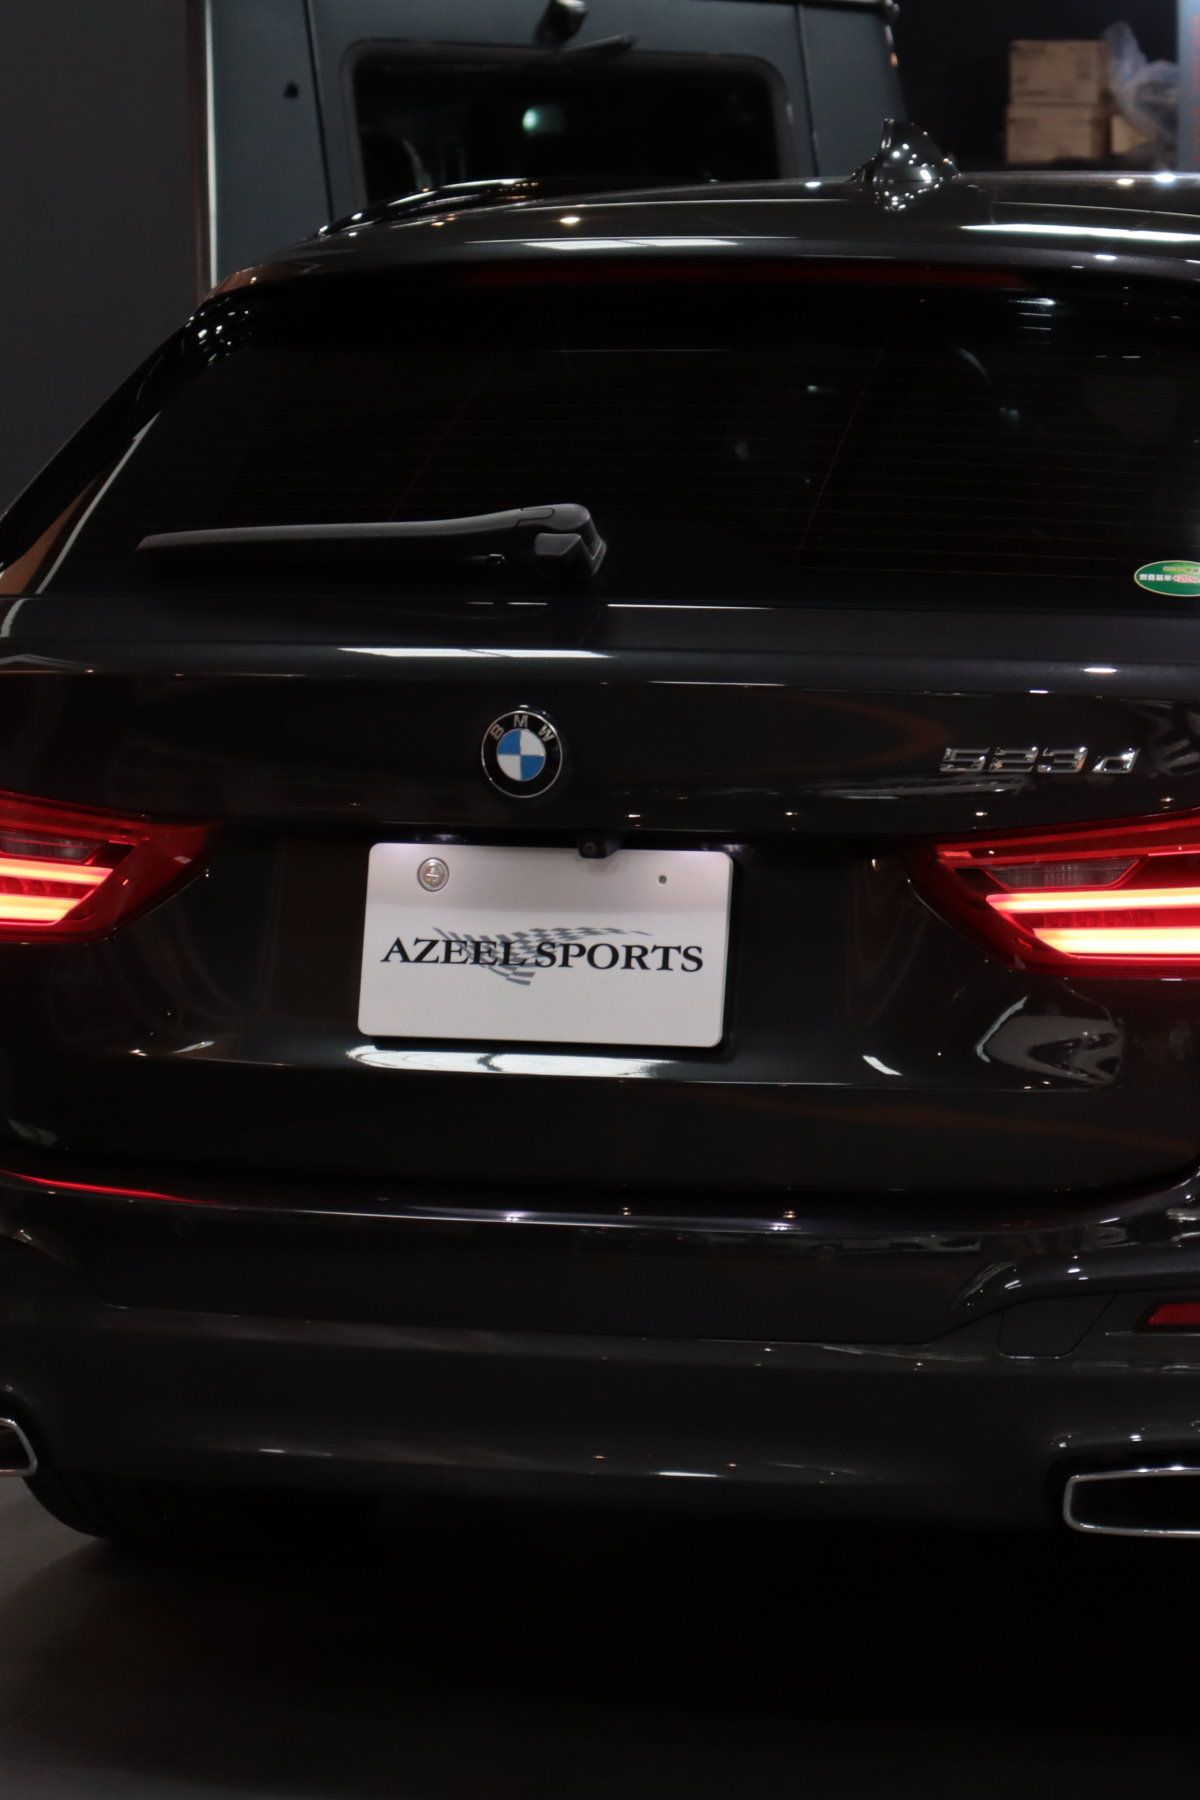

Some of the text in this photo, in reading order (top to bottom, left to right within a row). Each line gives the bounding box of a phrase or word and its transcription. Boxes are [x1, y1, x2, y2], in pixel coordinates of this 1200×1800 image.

[488, 714, 556, 743] BMW
[381, 936, 704, 972] AZEEL SPORTS
